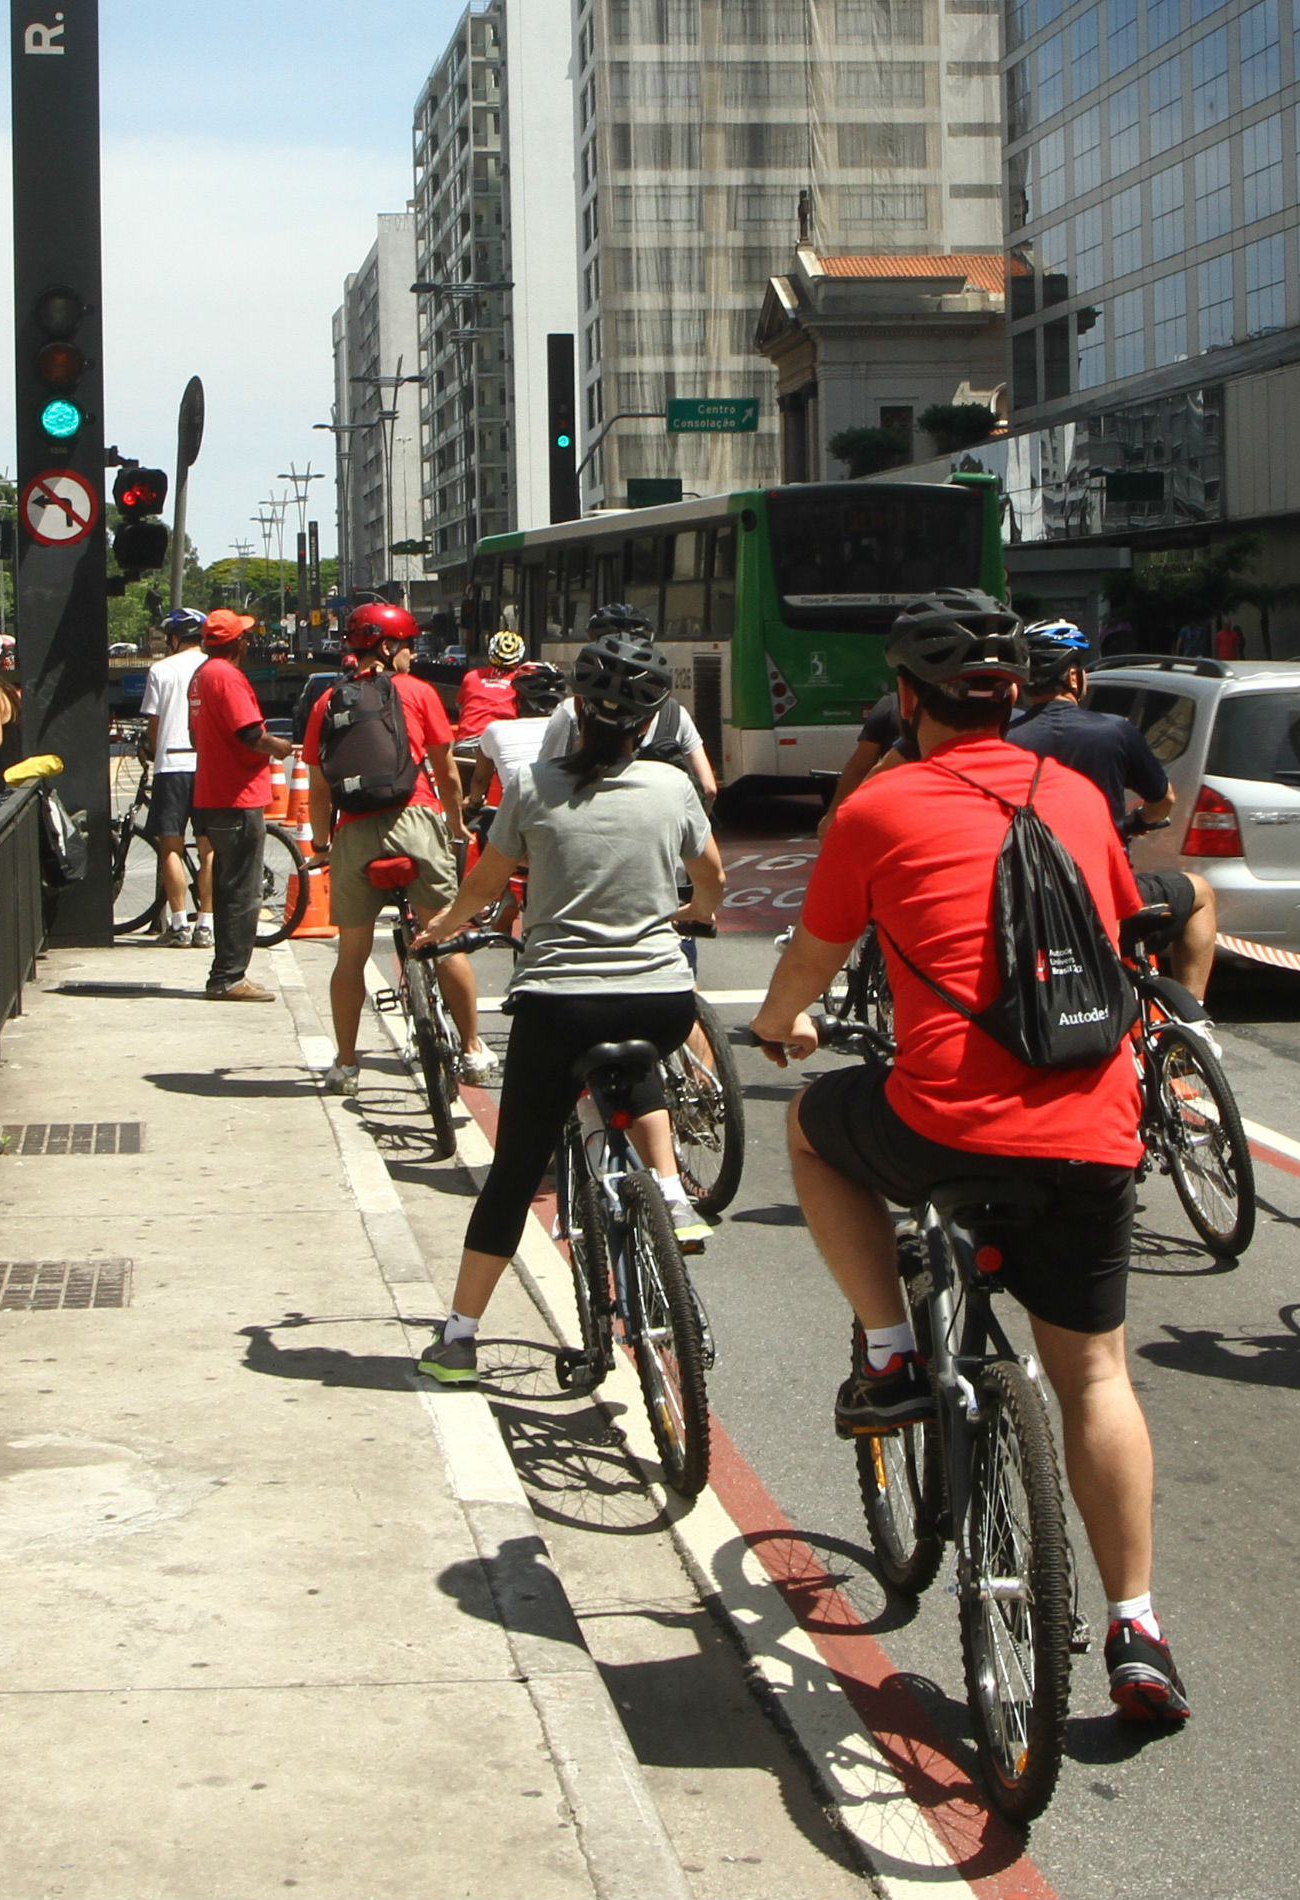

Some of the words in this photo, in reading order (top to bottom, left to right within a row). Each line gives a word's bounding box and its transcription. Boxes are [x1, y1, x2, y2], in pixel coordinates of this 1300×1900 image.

[24, 11, 66, 56] R.
[697, 404, 736, 415] Centro
[673, 418, 736, 430] Consolação
[878, 595, 896, 604] 181
